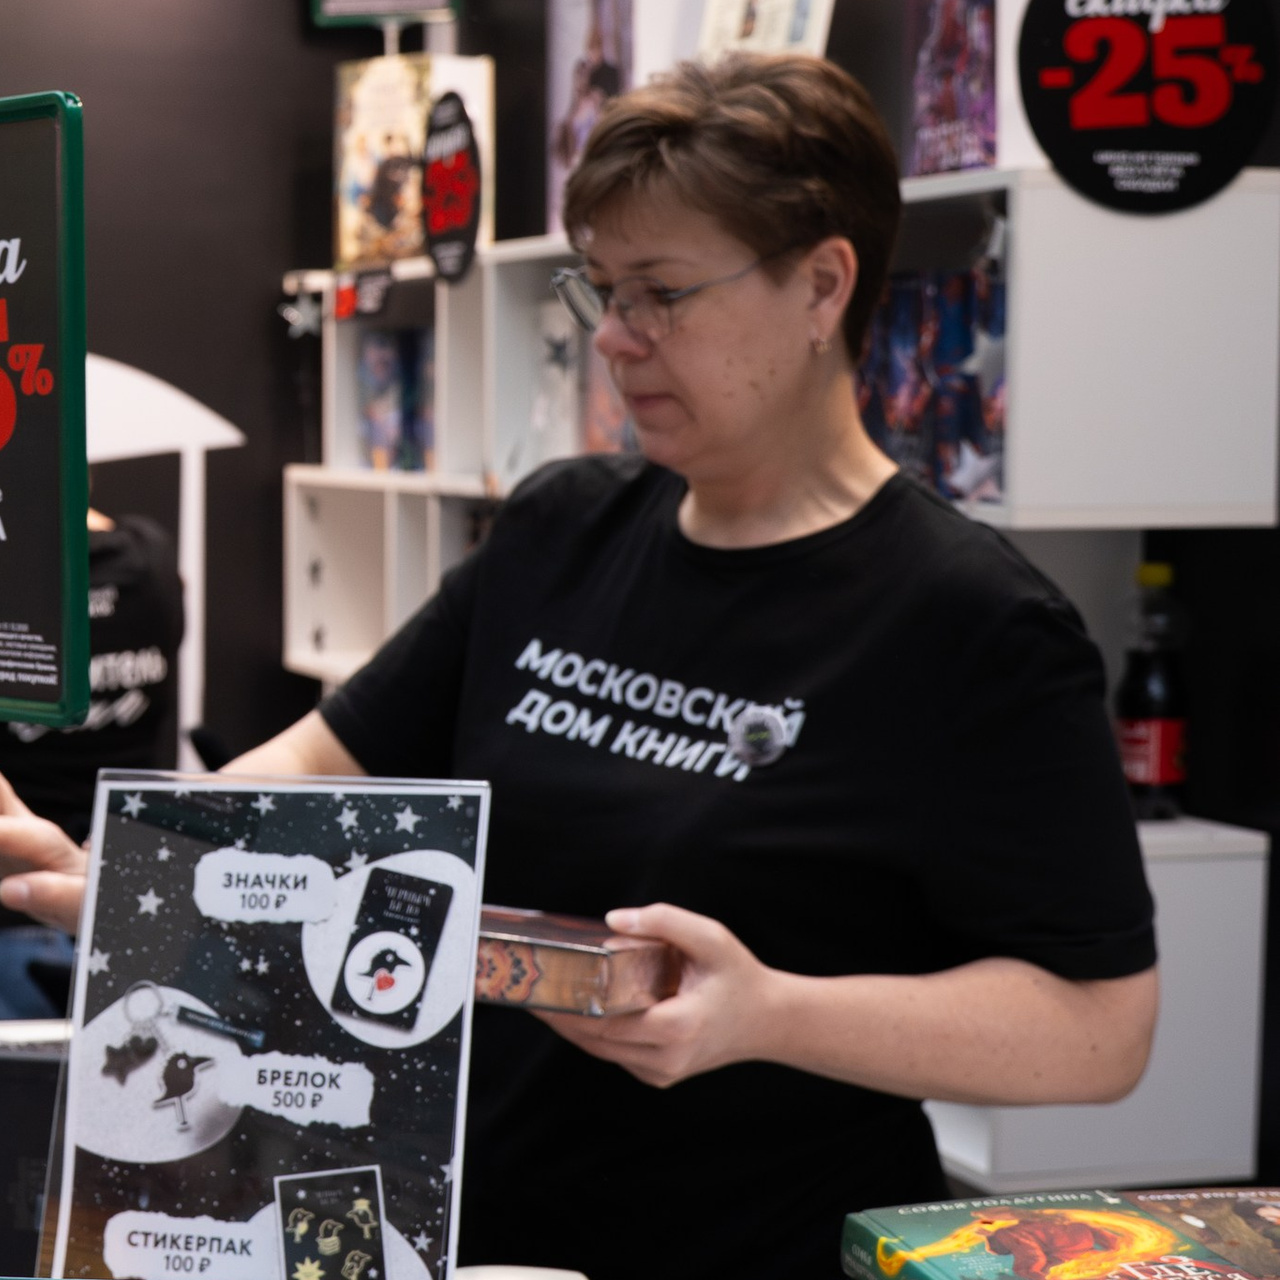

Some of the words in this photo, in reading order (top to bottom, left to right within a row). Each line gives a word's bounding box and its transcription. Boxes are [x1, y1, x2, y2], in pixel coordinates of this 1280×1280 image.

[514, 637, 806, 748] МОСКОВСКЙ
[505, 688, 612, 748] ДОМ
[223, 871, 308, 893] ЗНАЧКИ
[240, 894, 269, 910] 100
[257, 1069, 341, 1090] БРЕЛОК
[272, 1092, 304, 1108] 500
[127, 1230, 252, 1256] СТИКЕРПАК
[164, 1256, 193, 1272] 100
